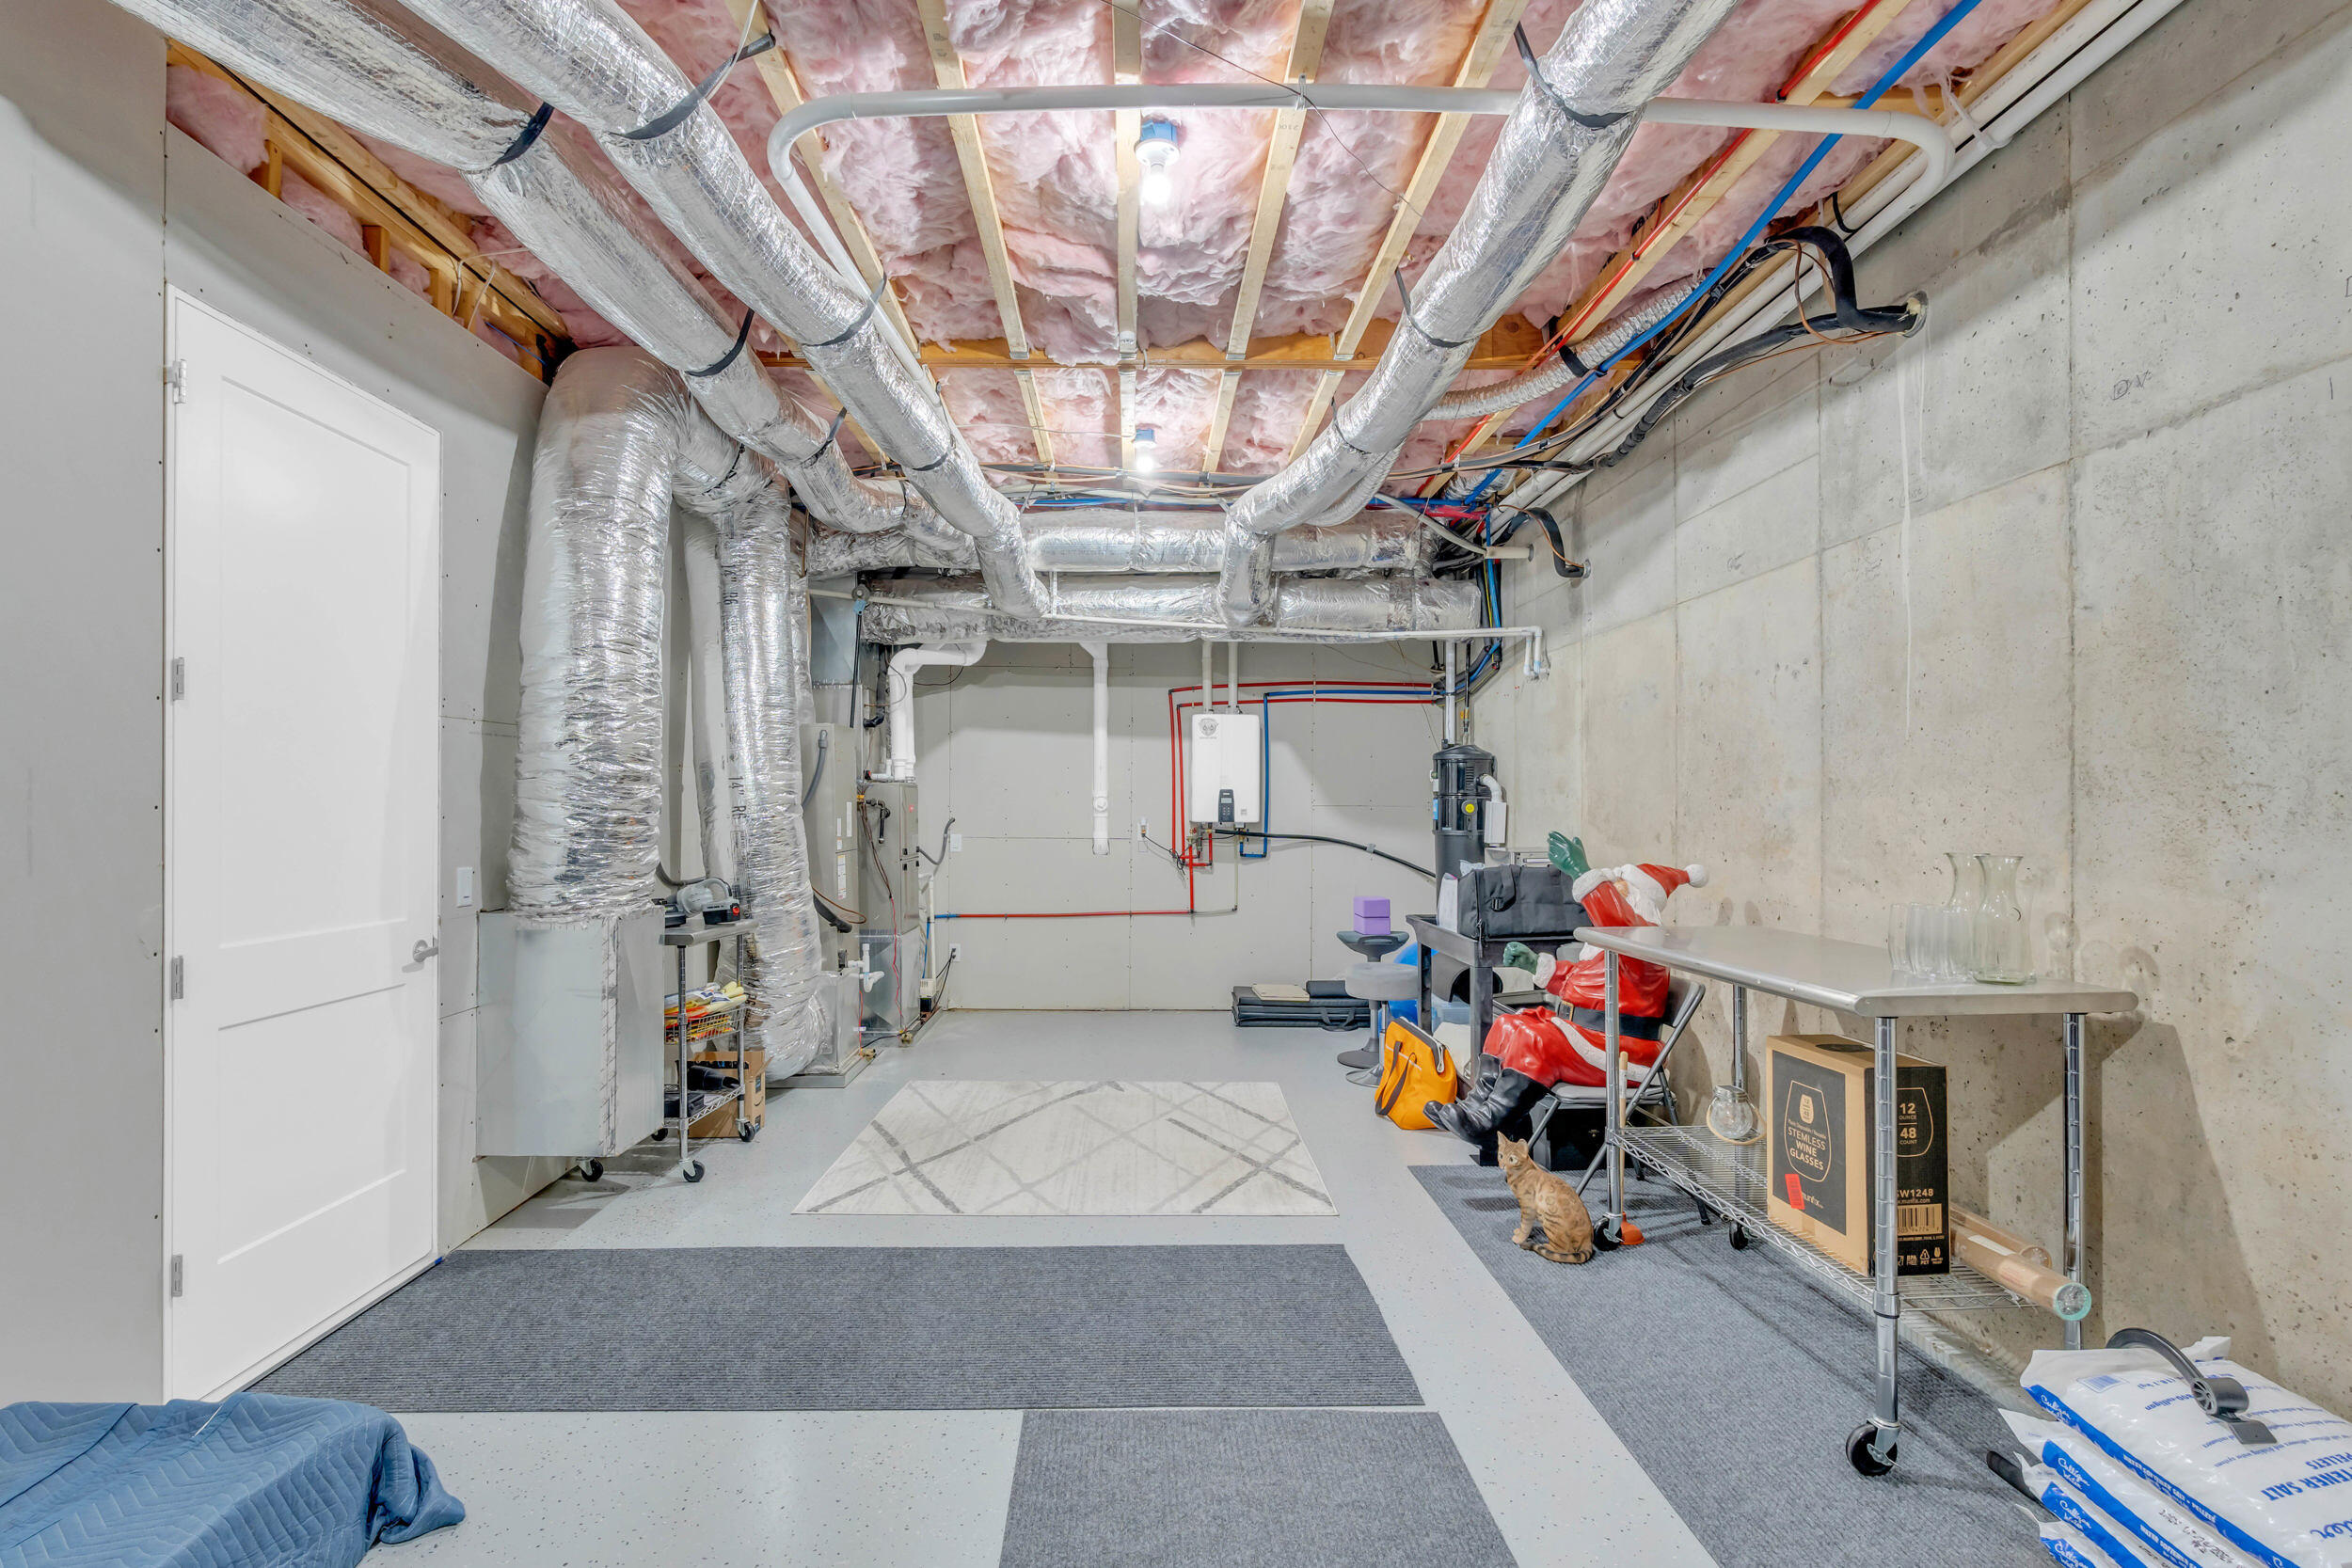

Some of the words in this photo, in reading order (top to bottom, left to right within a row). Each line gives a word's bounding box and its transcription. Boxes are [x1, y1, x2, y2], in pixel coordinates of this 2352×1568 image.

[1899, 1102, 1916, 1115] 12
[1788, 1127, 1826, 1151] STEMLESS
[1899, 1127, 1917, 1139] 48
[1789, 1148, 1824, 1171] GLASSES
[1796, 1139, 1817, 1157] WINE
[2058, 1457, 2090, 1487] Culligan
[2297, 1467, 2352, 1490] TENER
[2260, 1481, 2304, 1501] SALT
[2059, 1499, 2092, 1529] Culligan
